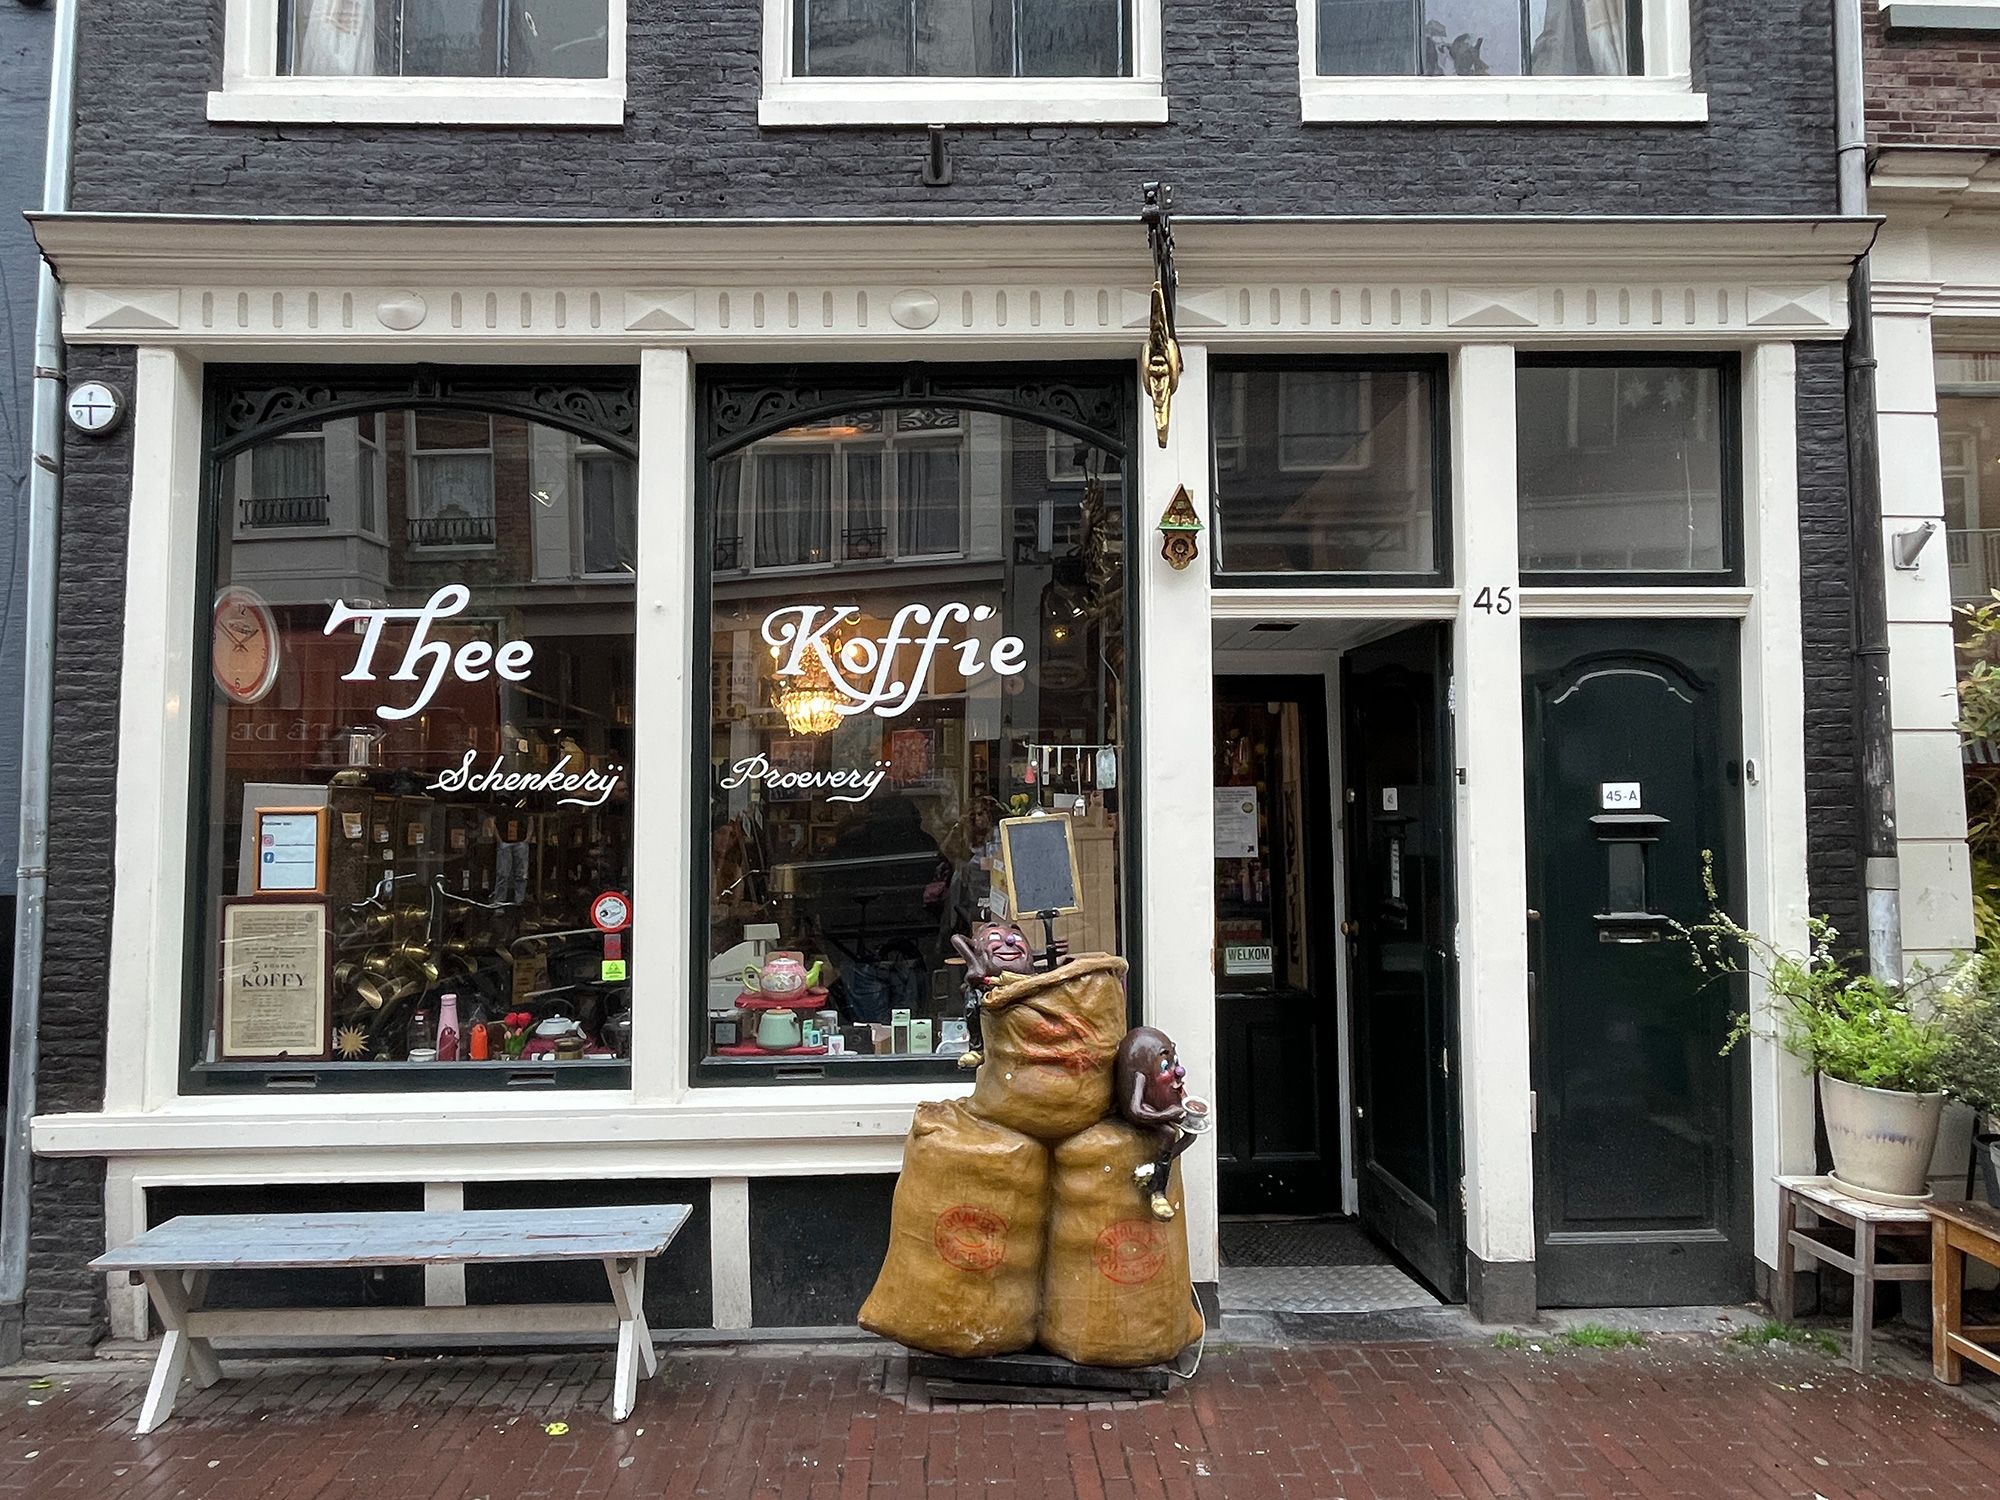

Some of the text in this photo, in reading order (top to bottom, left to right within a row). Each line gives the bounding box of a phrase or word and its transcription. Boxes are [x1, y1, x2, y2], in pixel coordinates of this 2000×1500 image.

[1473, 586, 1512, 615] 45
[323, 583, 534, 720] Thee
[760, 602, 1027, 718] Koffie
[425, 749, 624, 807] Schenkerij
[720, 752, 891, 803] Proeverij
[1605, 790, 1638, 802] 45-A
[1228, 948, 1270, 960] WELKOM
[242, 973, 307, 988] KOFFY
